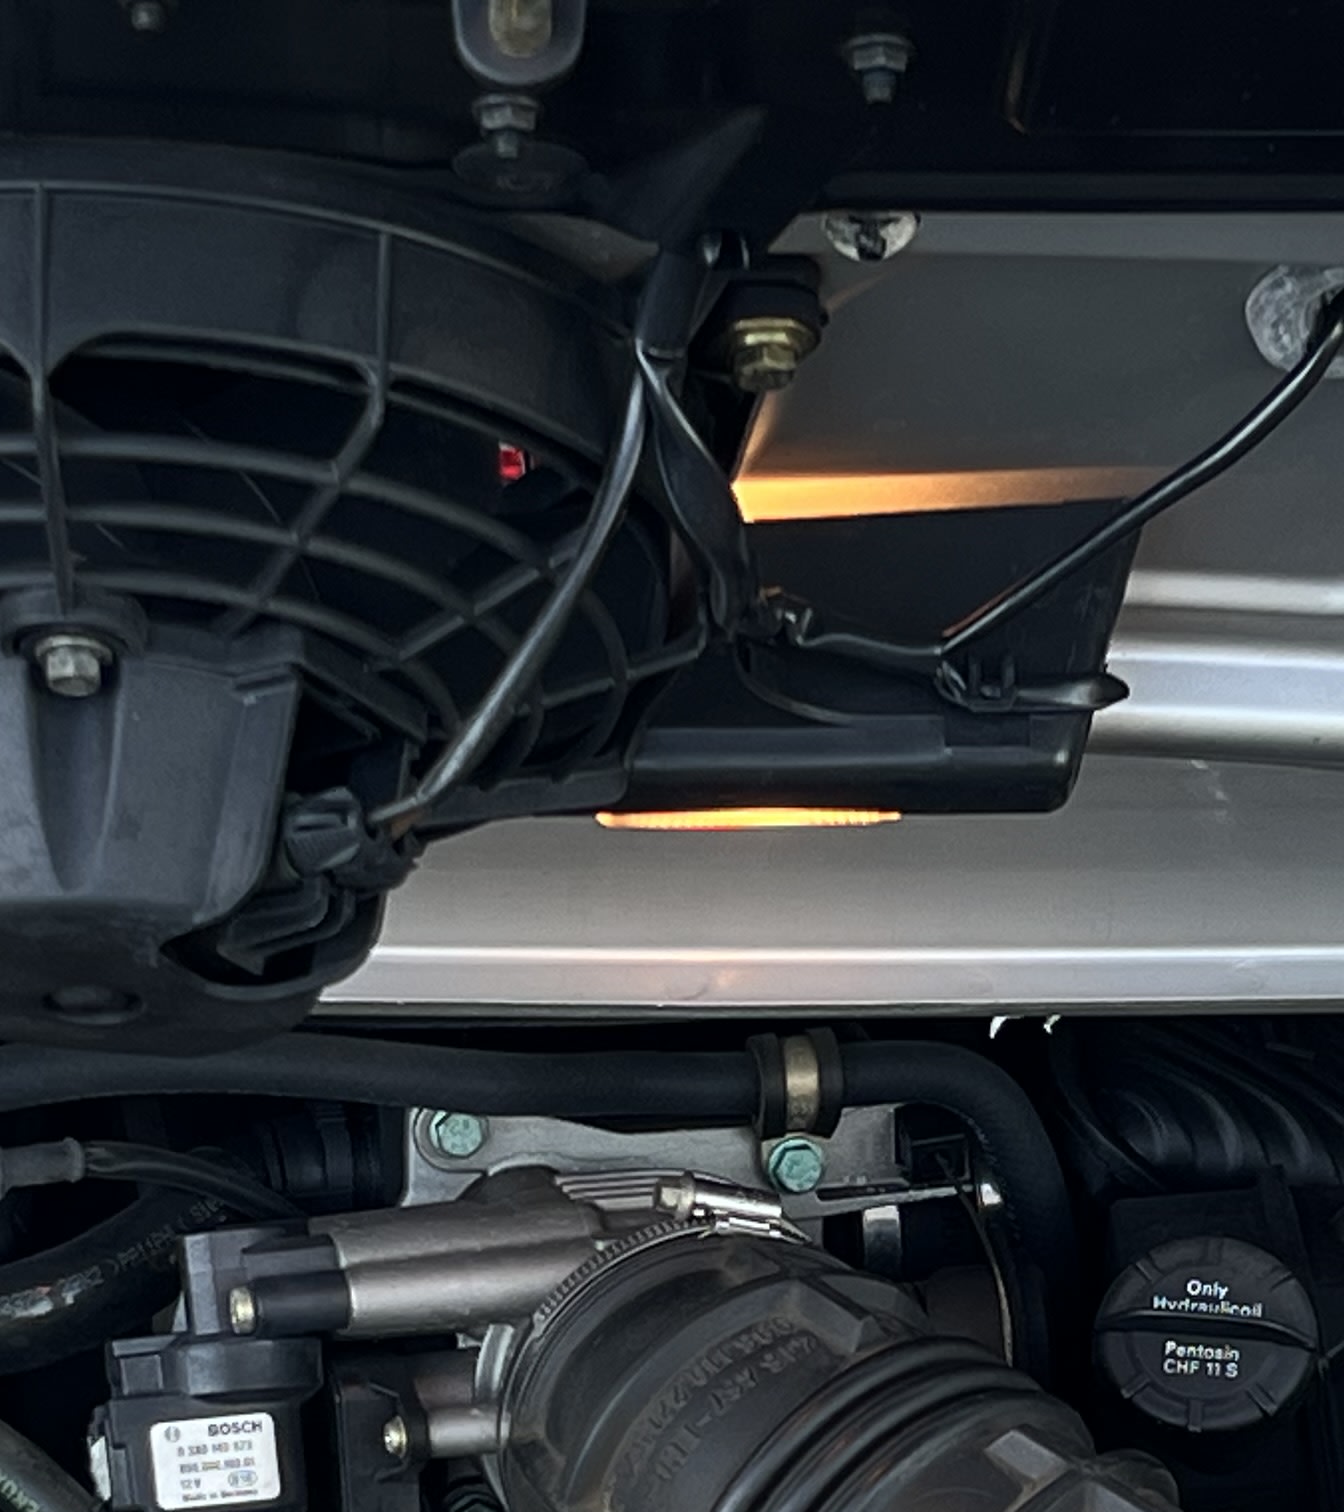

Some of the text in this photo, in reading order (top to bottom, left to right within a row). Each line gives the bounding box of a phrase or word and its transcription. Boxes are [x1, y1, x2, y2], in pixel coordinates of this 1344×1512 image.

[1186, 1279, 1230, 1300] Only
[1164, 1340, 1242, 1362] Pentosin
[1163, 1359, 1239, 1379] CHF 11 S
[207, 1419, 263, 1437] BOSCH
